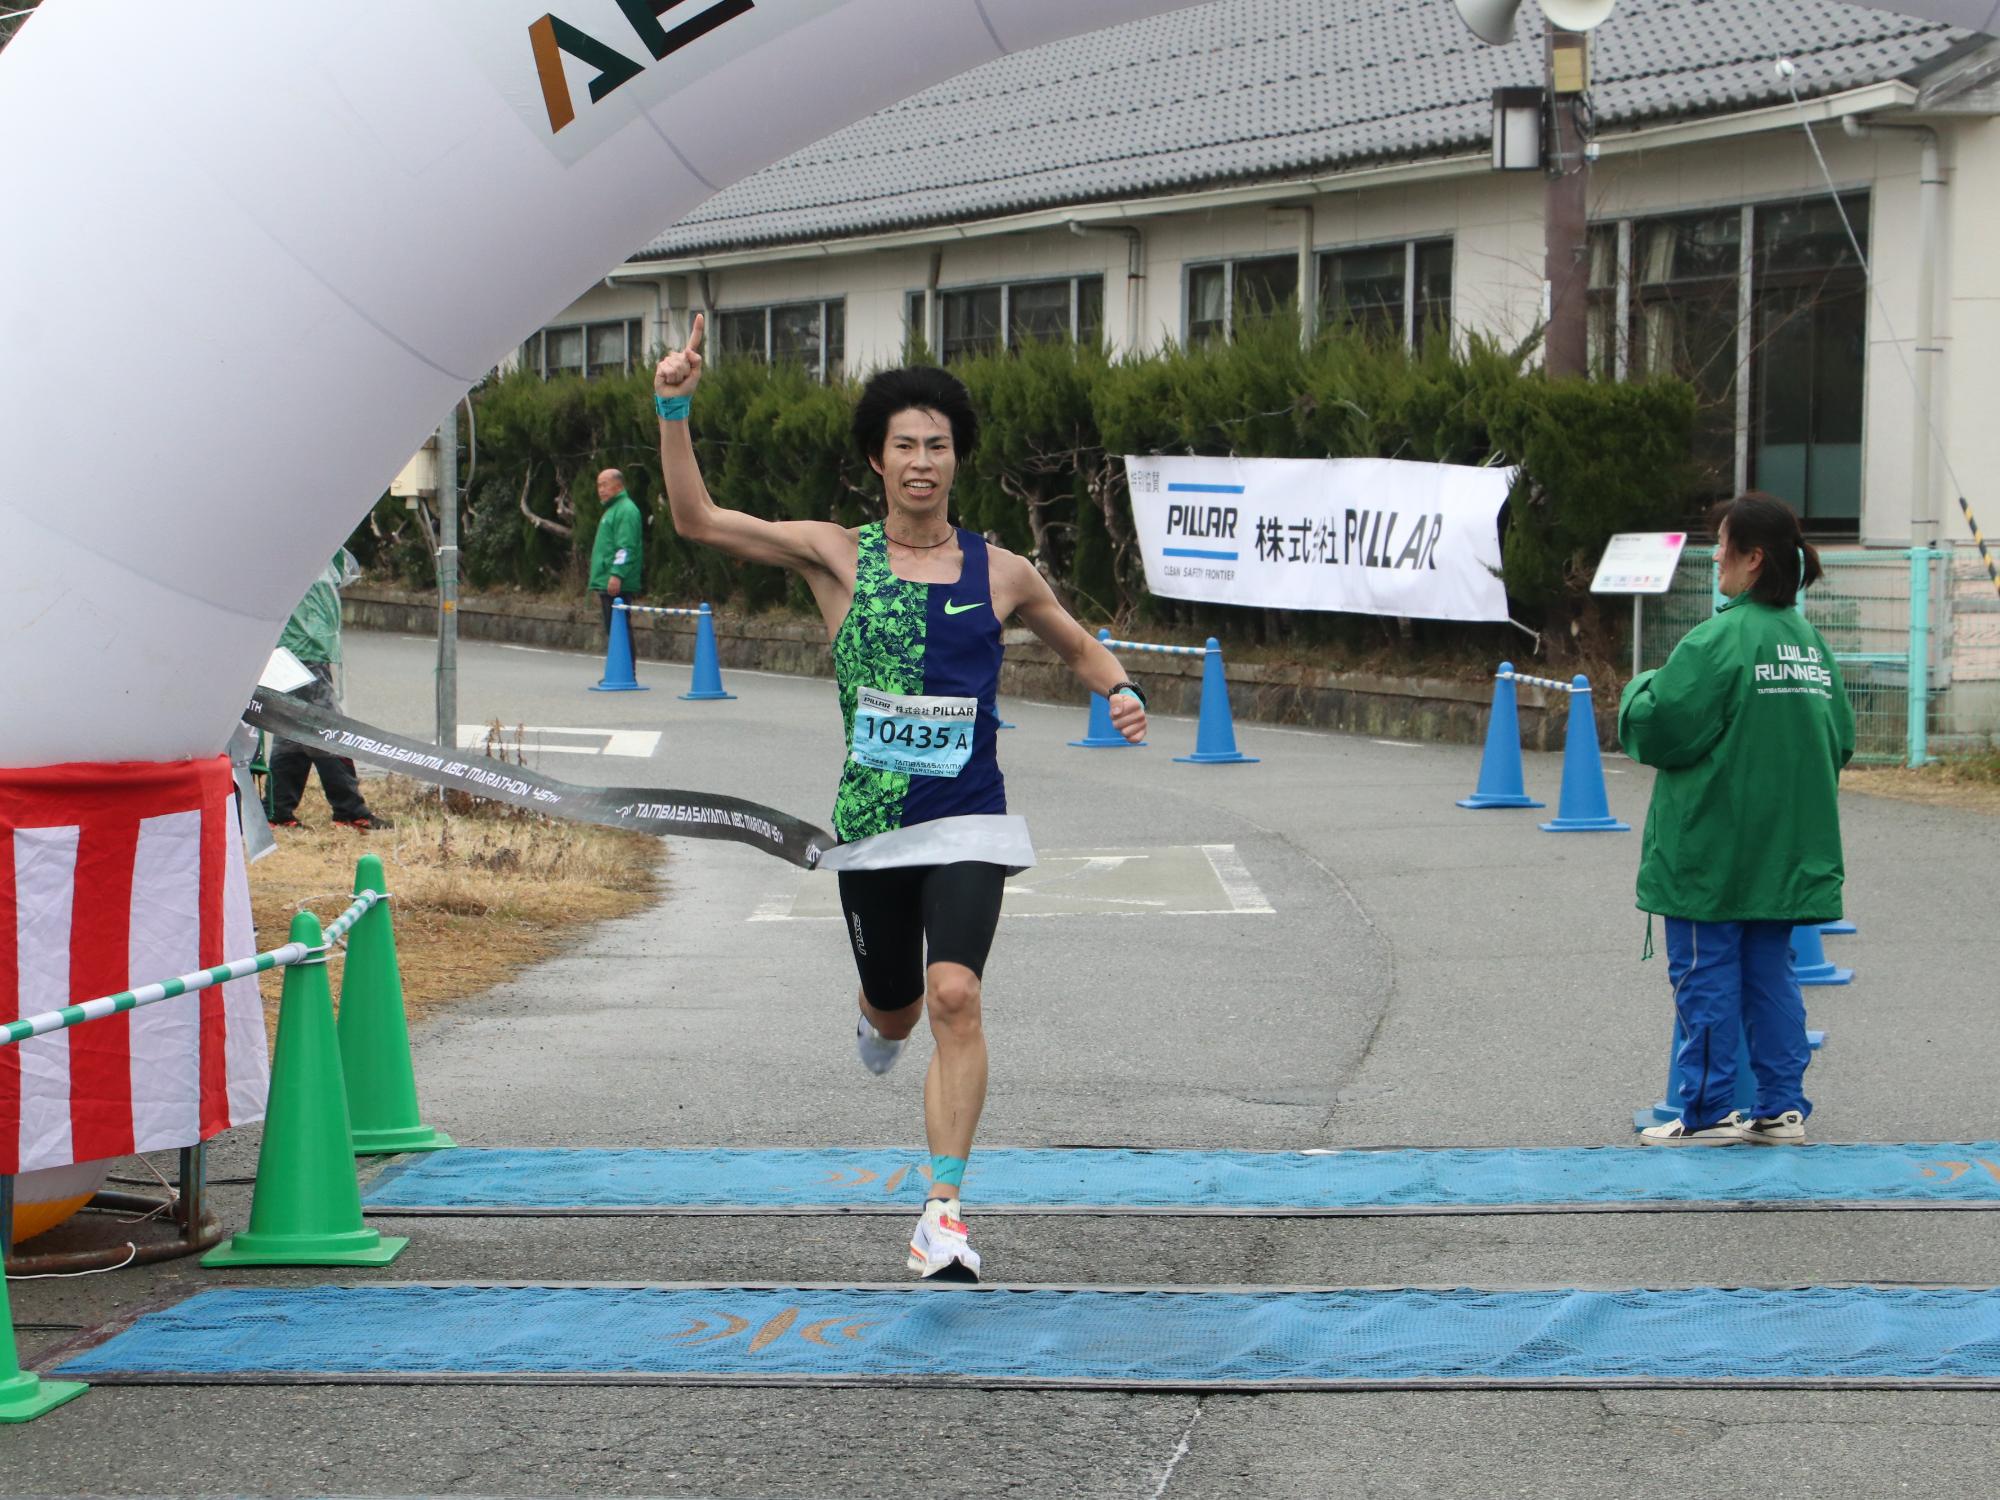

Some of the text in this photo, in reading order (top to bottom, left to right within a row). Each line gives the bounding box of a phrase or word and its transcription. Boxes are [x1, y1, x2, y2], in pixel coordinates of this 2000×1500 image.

[1166, 504, 1238, 539] PILLAR
[1344, 508, 1443, 570] PILLAR
[1776, 644, 1818, 662] WILD
[864, 697, 891, 709] PILLAR
[896, 705, 974, 716] 株式会社 PILLAR
[866, 717, 951, 748] 10435
[955, 732, 968, 750] A
[338, 731, 562, 805] TAMBASASAYAMA ABC MARATHON 45TH
[636, 803, 731, 826] TAMBASASAYAMA
[730, 811, 746, 829] ABC
